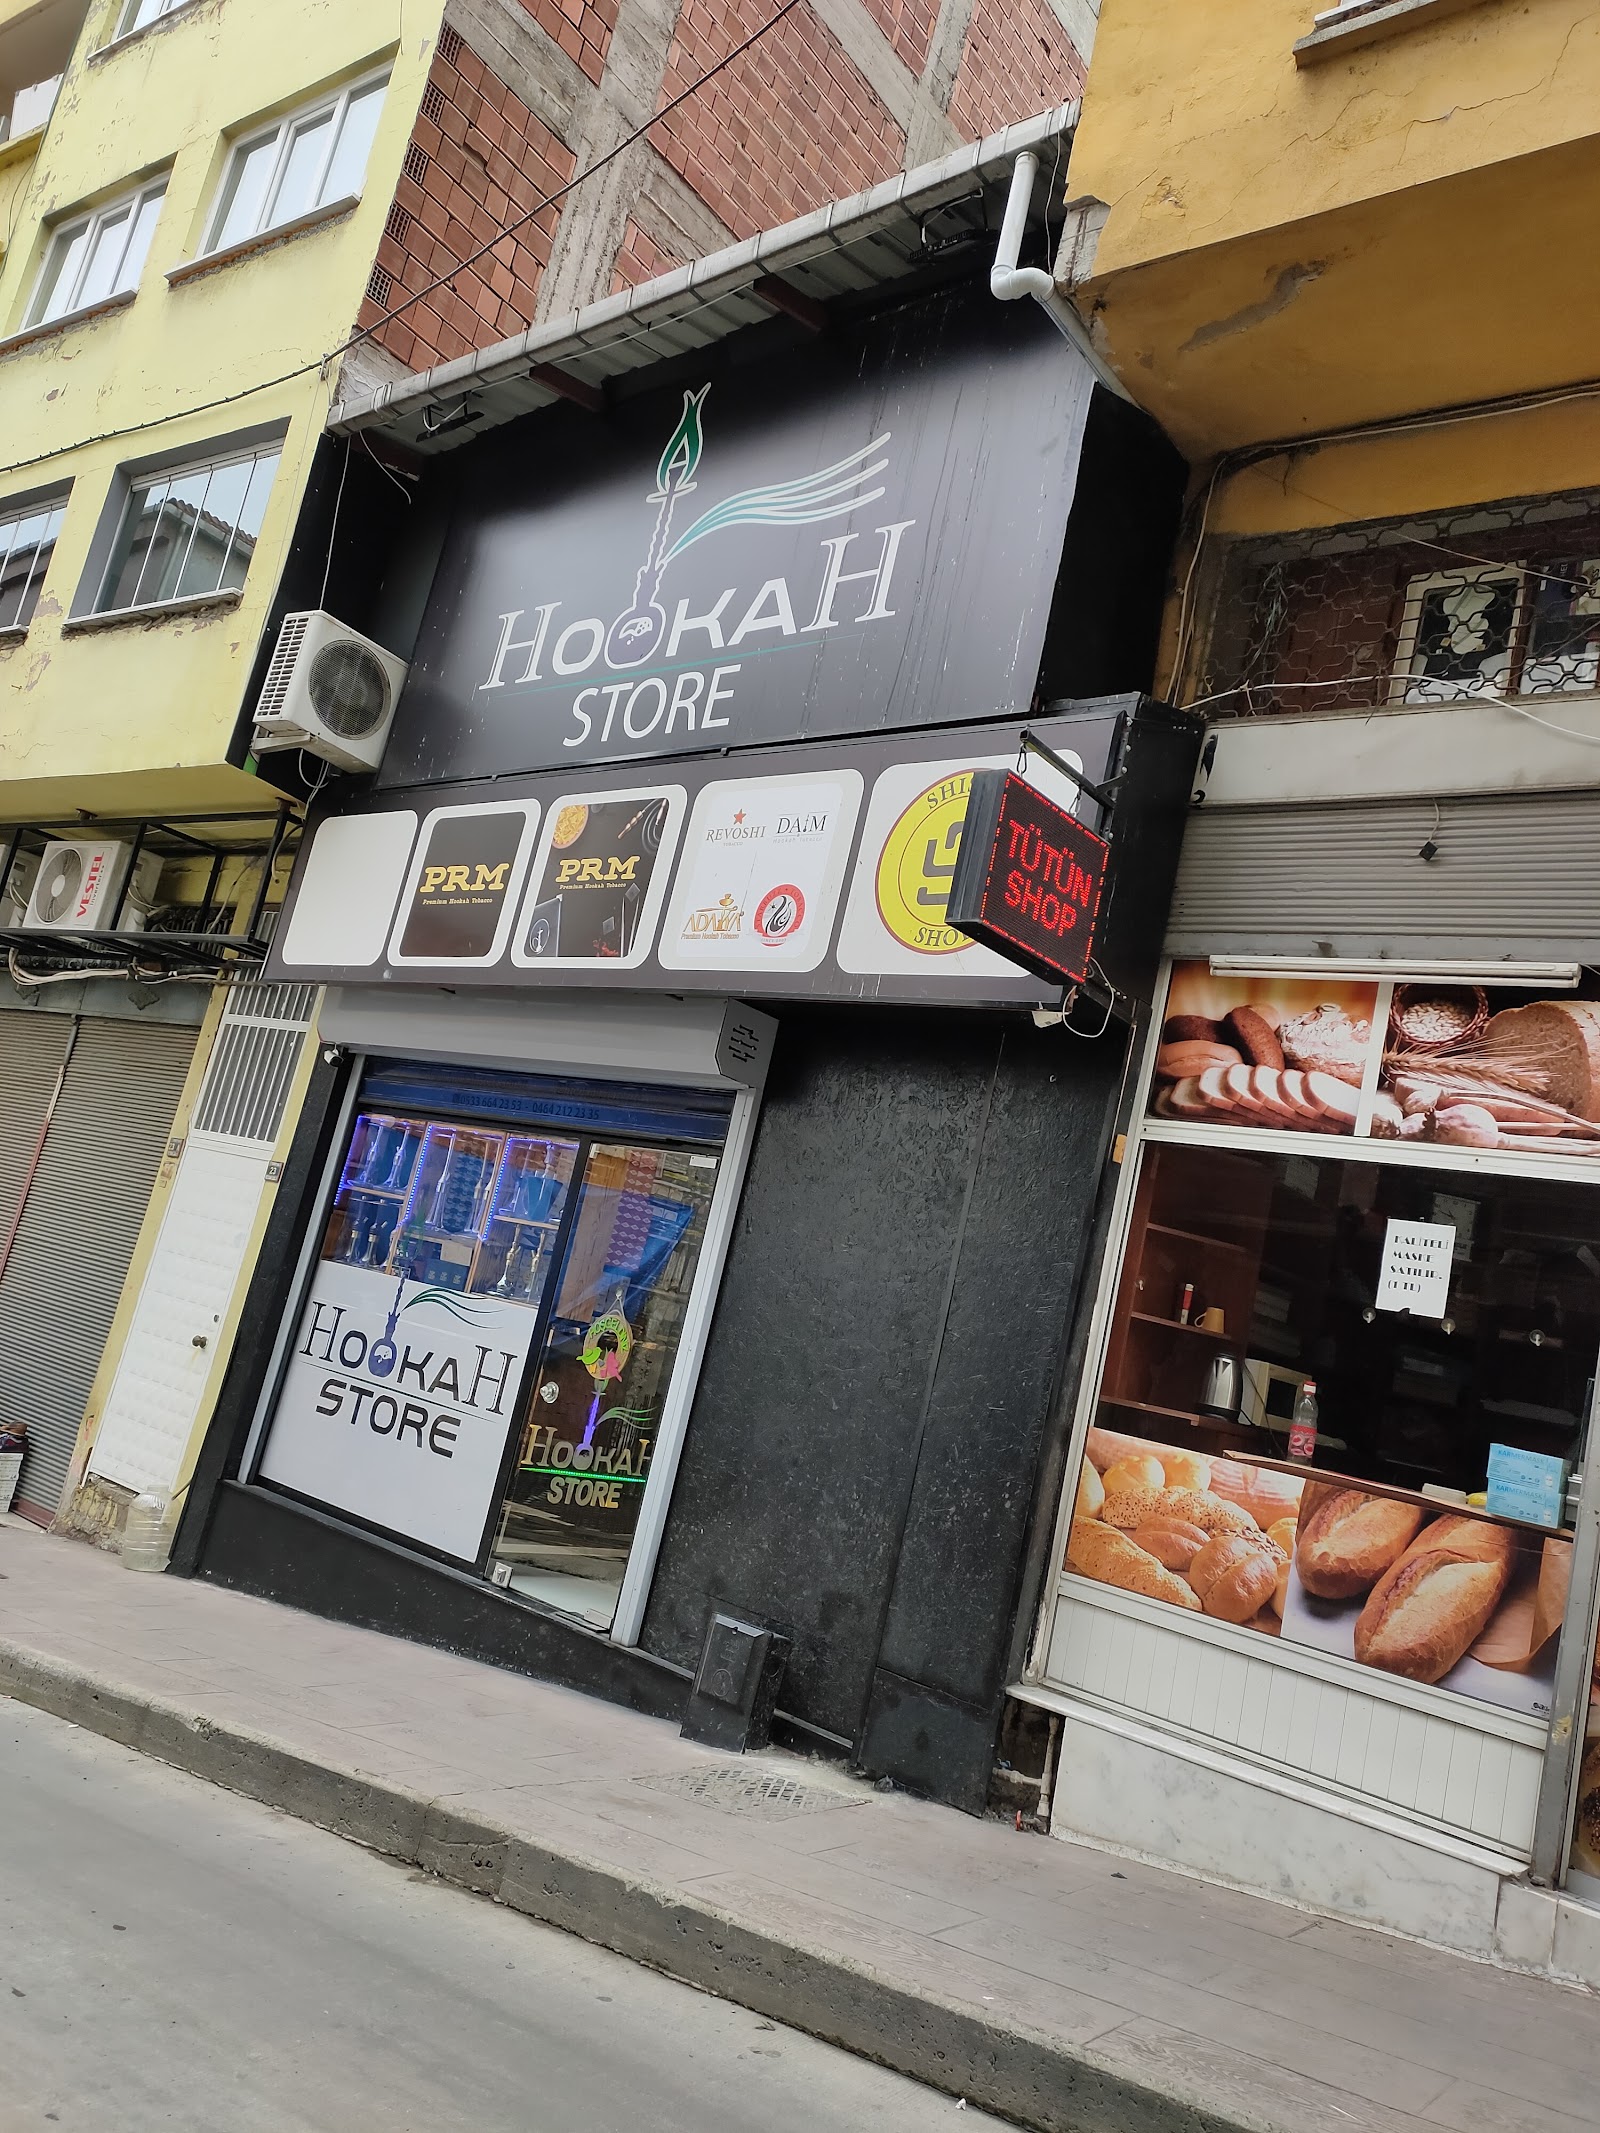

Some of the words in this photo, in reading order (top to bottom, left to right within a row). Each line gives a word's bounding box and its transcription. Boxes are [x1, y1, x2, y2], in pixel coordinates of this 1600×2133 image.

[479, 519, 916, 690] HOOKAH
[563, 664, 741, 747] STORE
[927, 777, 972, 810] SHI
[706, 826, 767, 843] REVOSHI
[420, 863, 510, 893] PRM
[555, 855, 641, 883] PRM
[1008, 819, 1092, 907] TÜTÜN
[76, 851, 105, 918] VESTEL
[1004, 869, 1077, 937] SHOP
[482, 1097, 497, 1108] 664
[498, 1098, 509, 1109] 23
[510, 1099, 522, 1111] 53
[555, 1105, 573, 1116] 212
[574, 1107, 586, 1118] 23
[588, 1108, 600, 1120] 35
[1392, 1251, 1434, 1263] MASKE
[299, 1301, 518, 1415] HOOKAH
[315, 1378, 461, 1459] STORE
[547, 1476, 623, 1508] STORE
[1496, 1484, 1543, 1500] KARMERMASK
